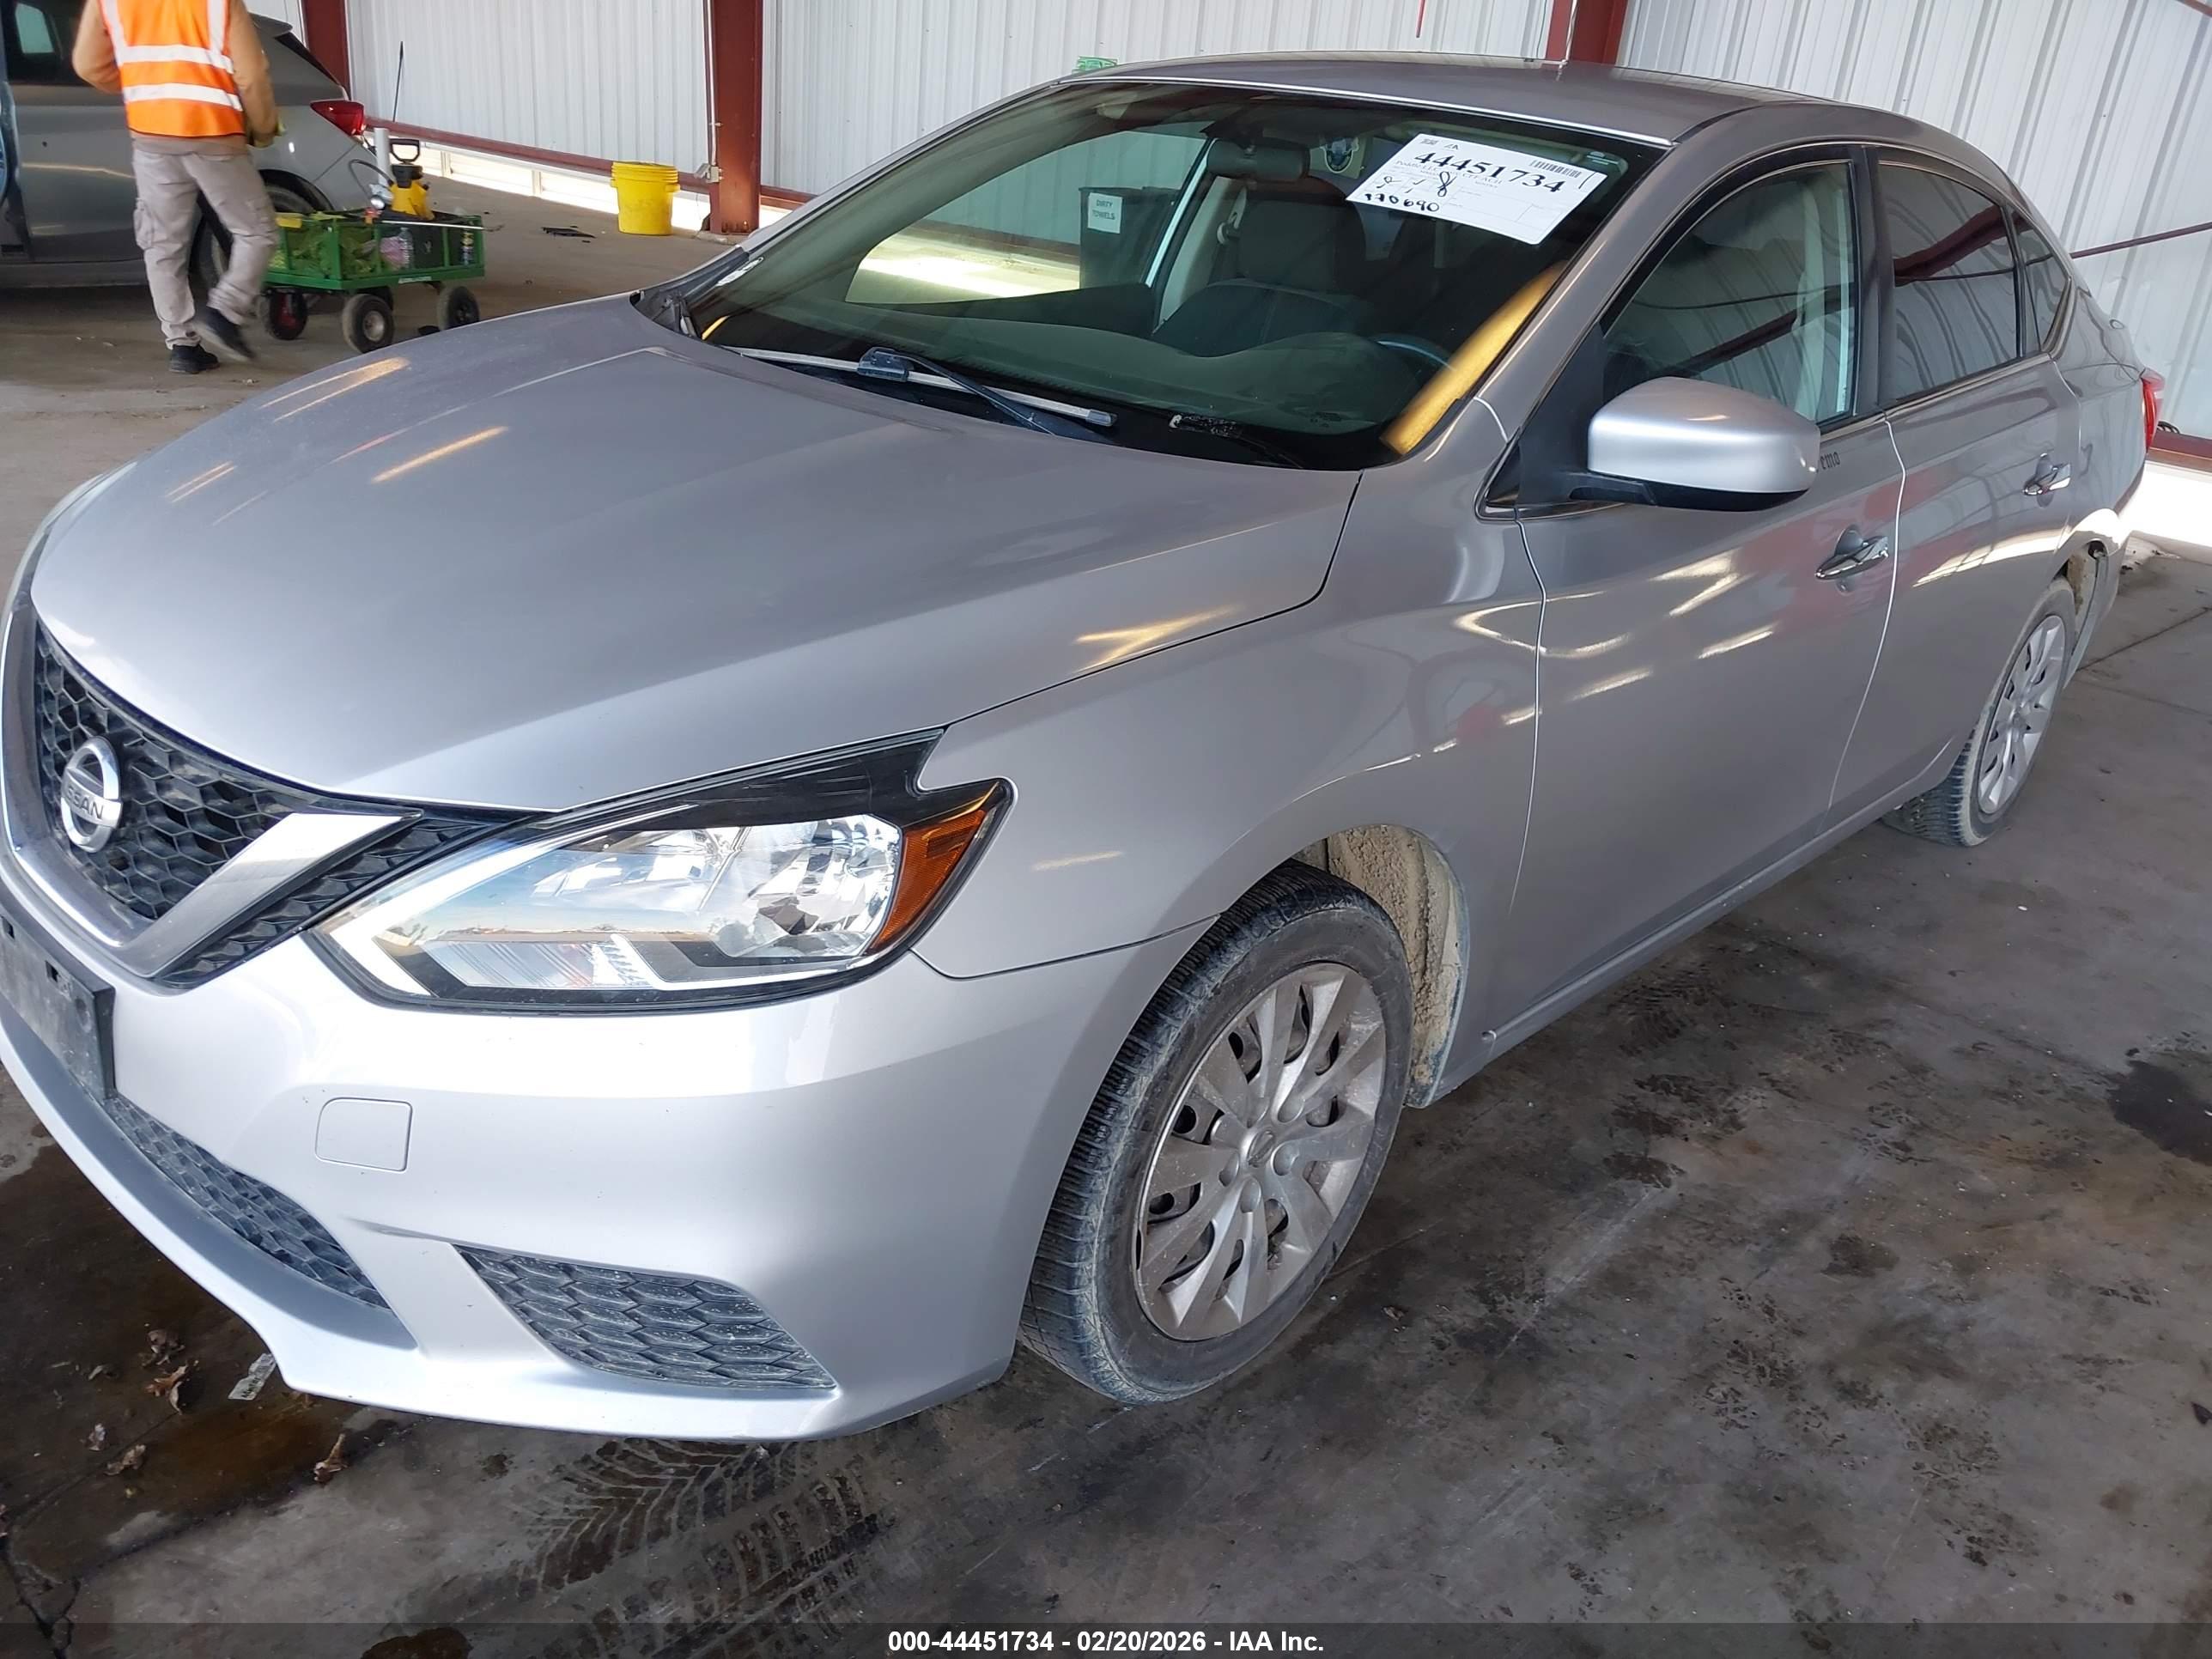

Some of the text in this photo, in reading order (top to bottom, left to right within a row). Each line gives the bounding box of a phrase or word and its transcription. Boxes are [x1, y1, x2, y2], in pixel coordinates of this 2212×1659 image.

[1413, 151, 1566, 194] 44451734
[1096, 199, 1114, 208] DIRTY
[1819, 451, 1841, 471] emo
